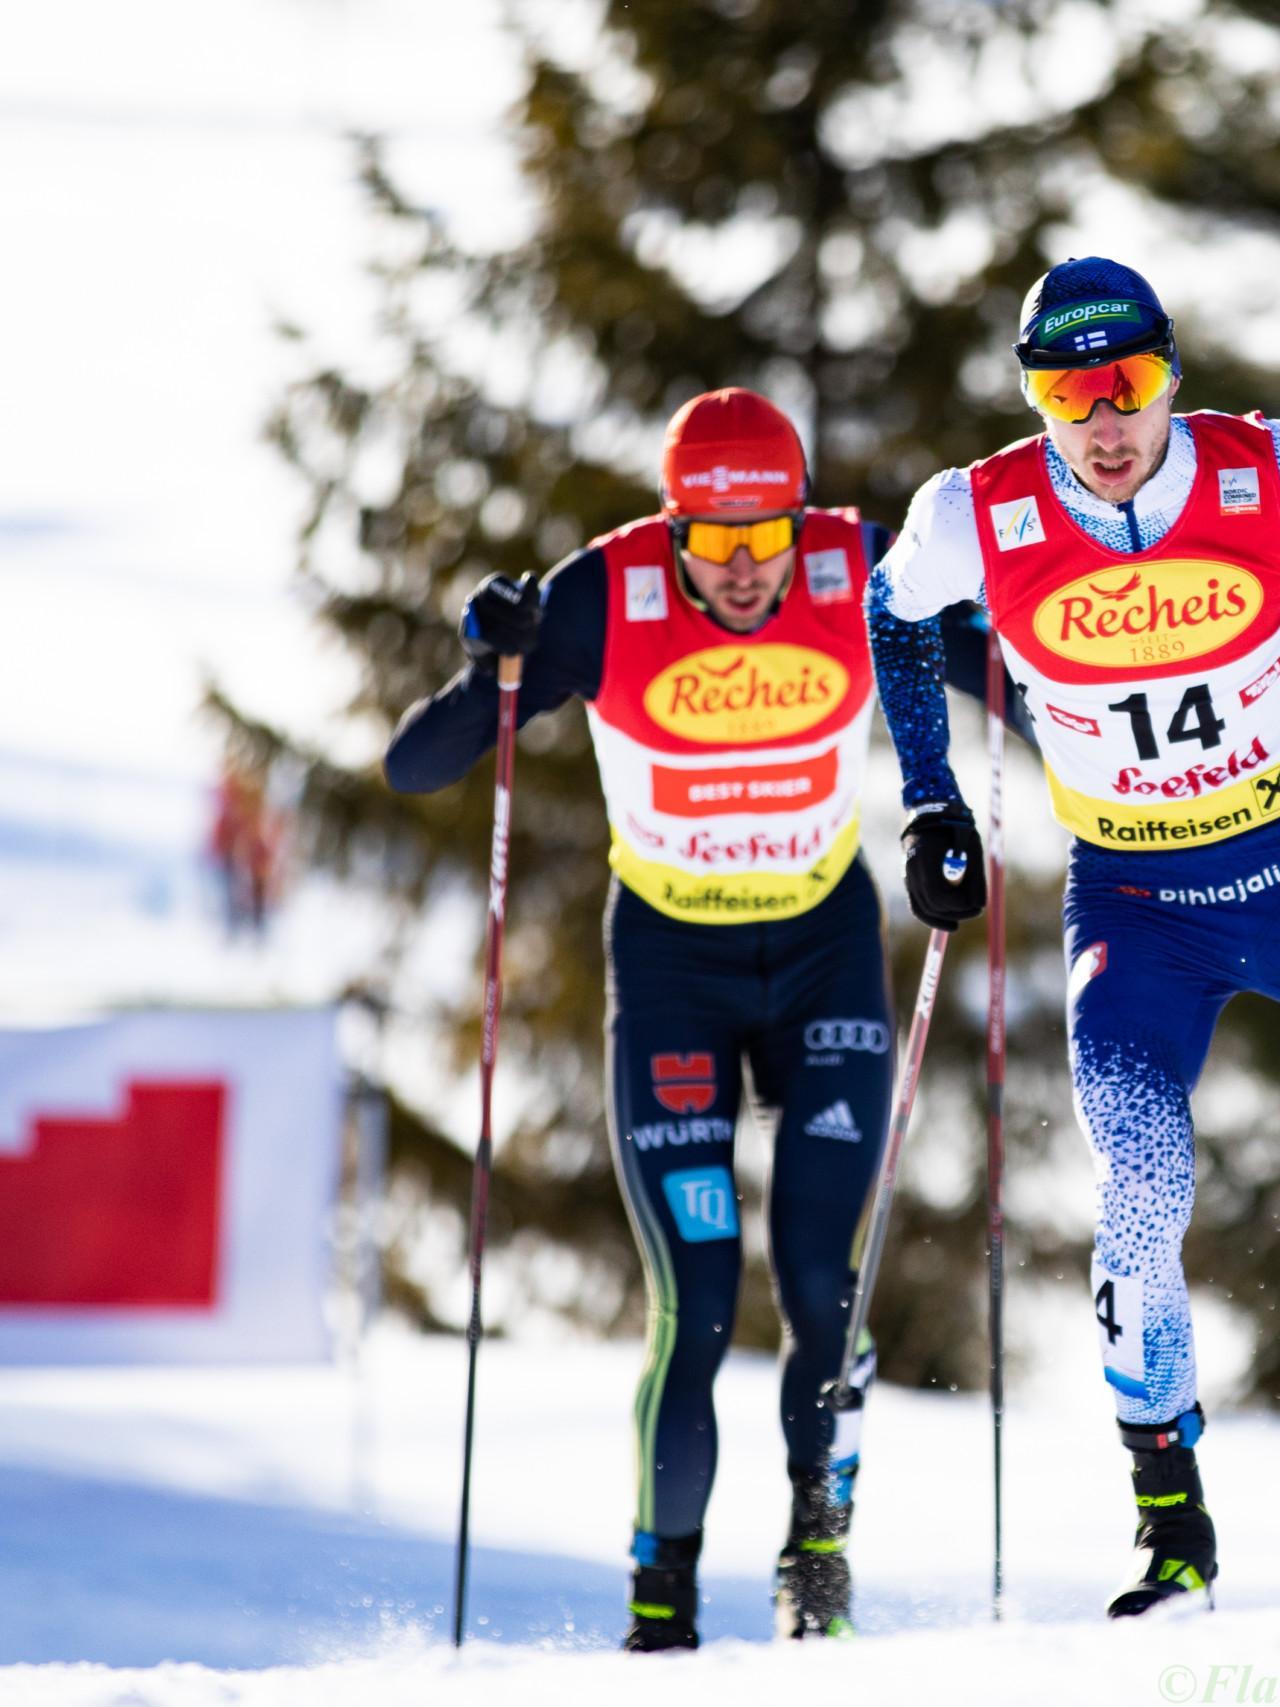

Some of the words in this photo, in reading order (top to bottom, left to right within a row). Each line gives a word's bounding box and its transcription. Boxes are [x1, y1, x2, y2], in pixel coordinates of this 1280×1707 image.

[1044, 300, 1130, 334] Europcar
[1058, 578, 1247, 641] Recheis
[1129, 640, 1185, 662] 1889
[669, 667, 831, 717] Recheis
[1108, 683, 1226, 760] 14
[1111, 737, 1270, 798] Seefeld
[688, 781, 744, 802] BEST
[748, 777, 812, 799] SKIER
[1098, 807, 1252, 842] Raiffeisen
[681, 830, 821, 863] Seefeld
[664, 882, 798, 909] Raiffeisen
